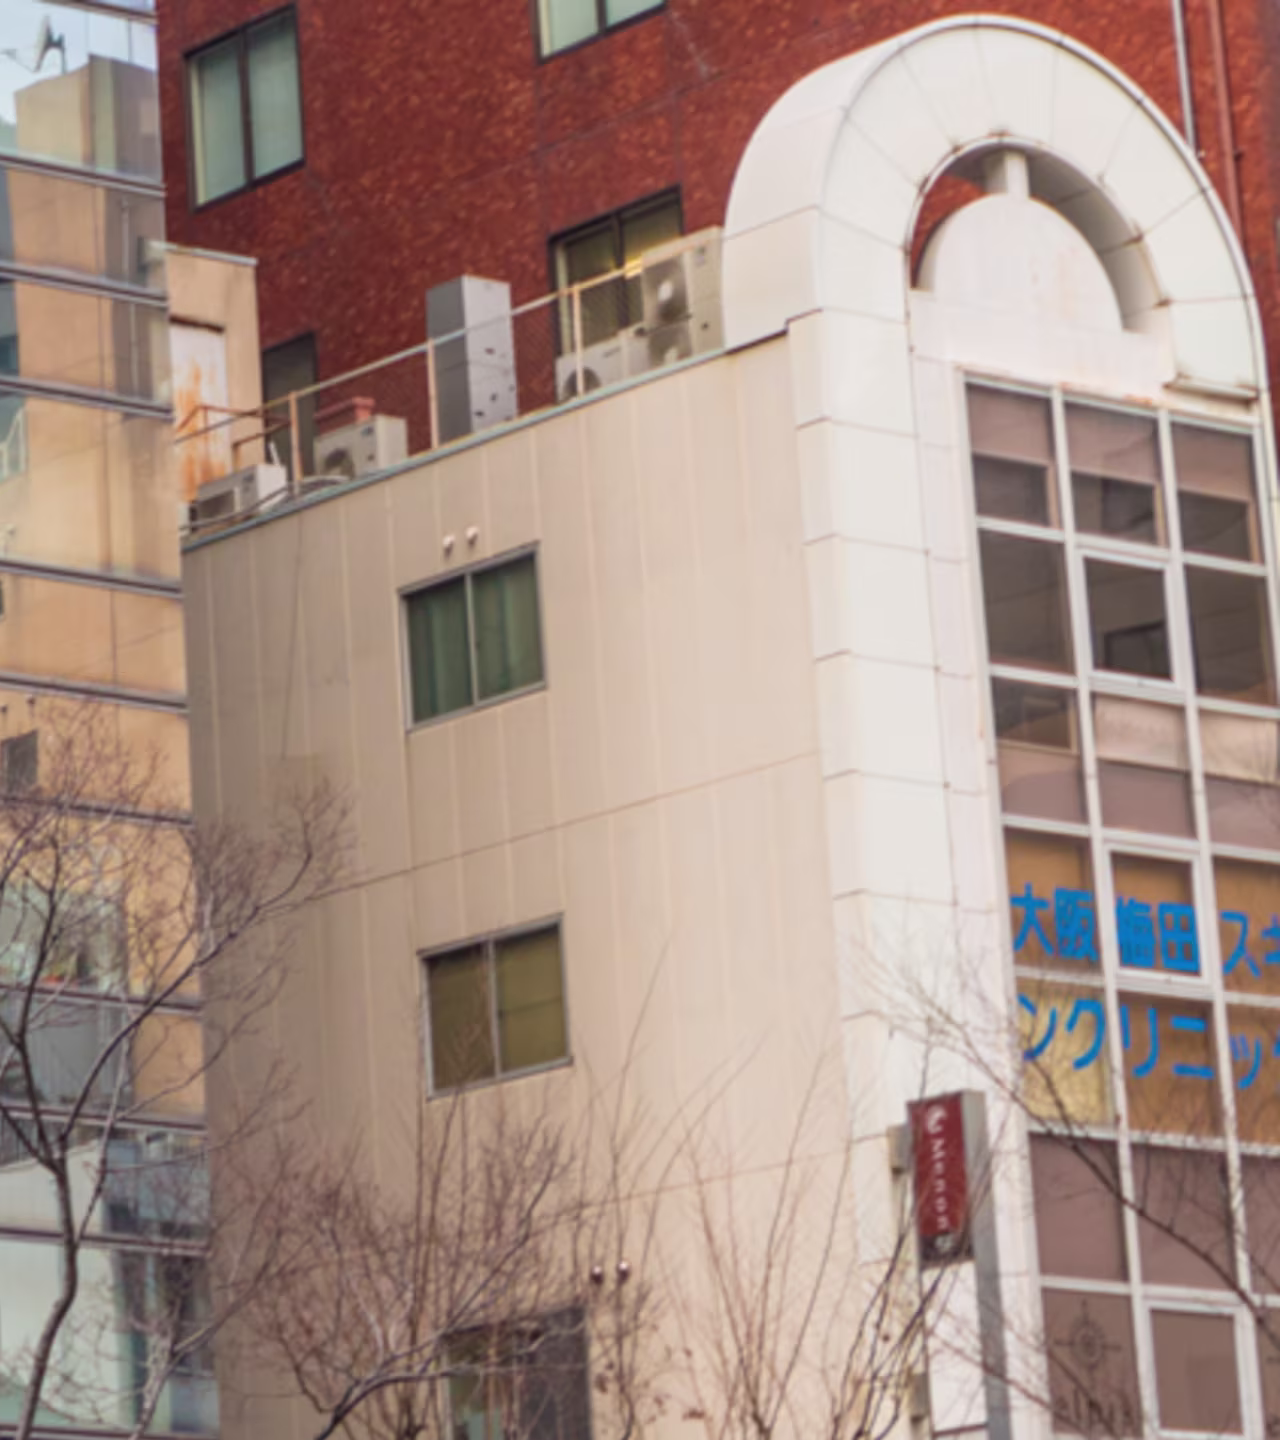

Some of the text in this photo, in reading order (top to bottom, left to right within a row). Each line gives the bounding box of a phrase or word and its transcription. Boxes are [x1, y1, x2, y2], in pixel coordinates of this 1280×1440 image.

[1016, 993, 1280, 1089] ンクリニッ
